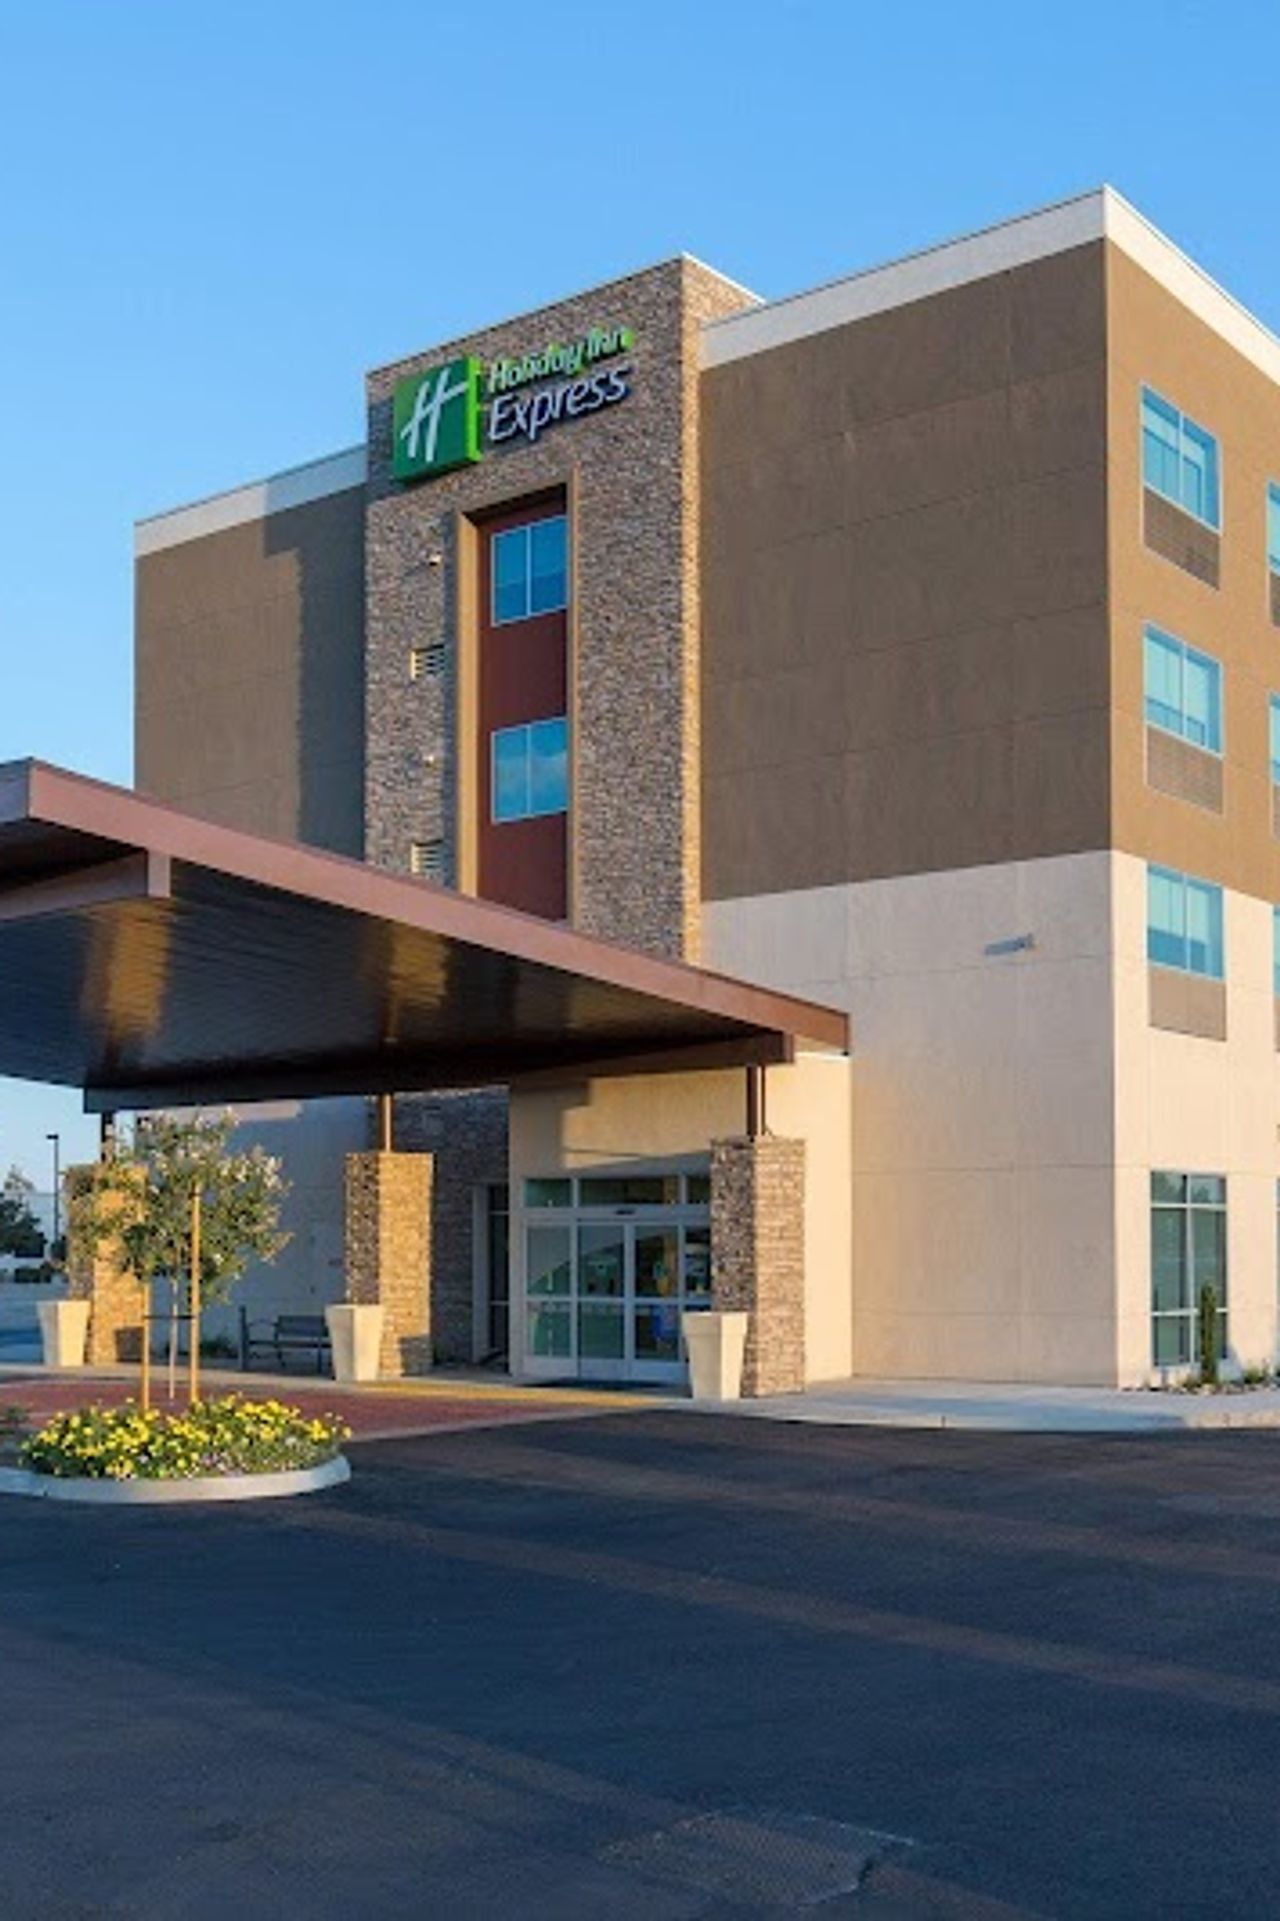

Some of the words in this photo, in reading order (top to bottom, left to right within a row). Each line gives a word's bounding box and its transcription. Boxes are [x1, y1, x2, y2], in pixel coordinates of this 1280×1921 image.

[489, 342, 585, 393] Holiday
[587, 326, 634, 361] Inn
[489, 362, 630, 442] Express
